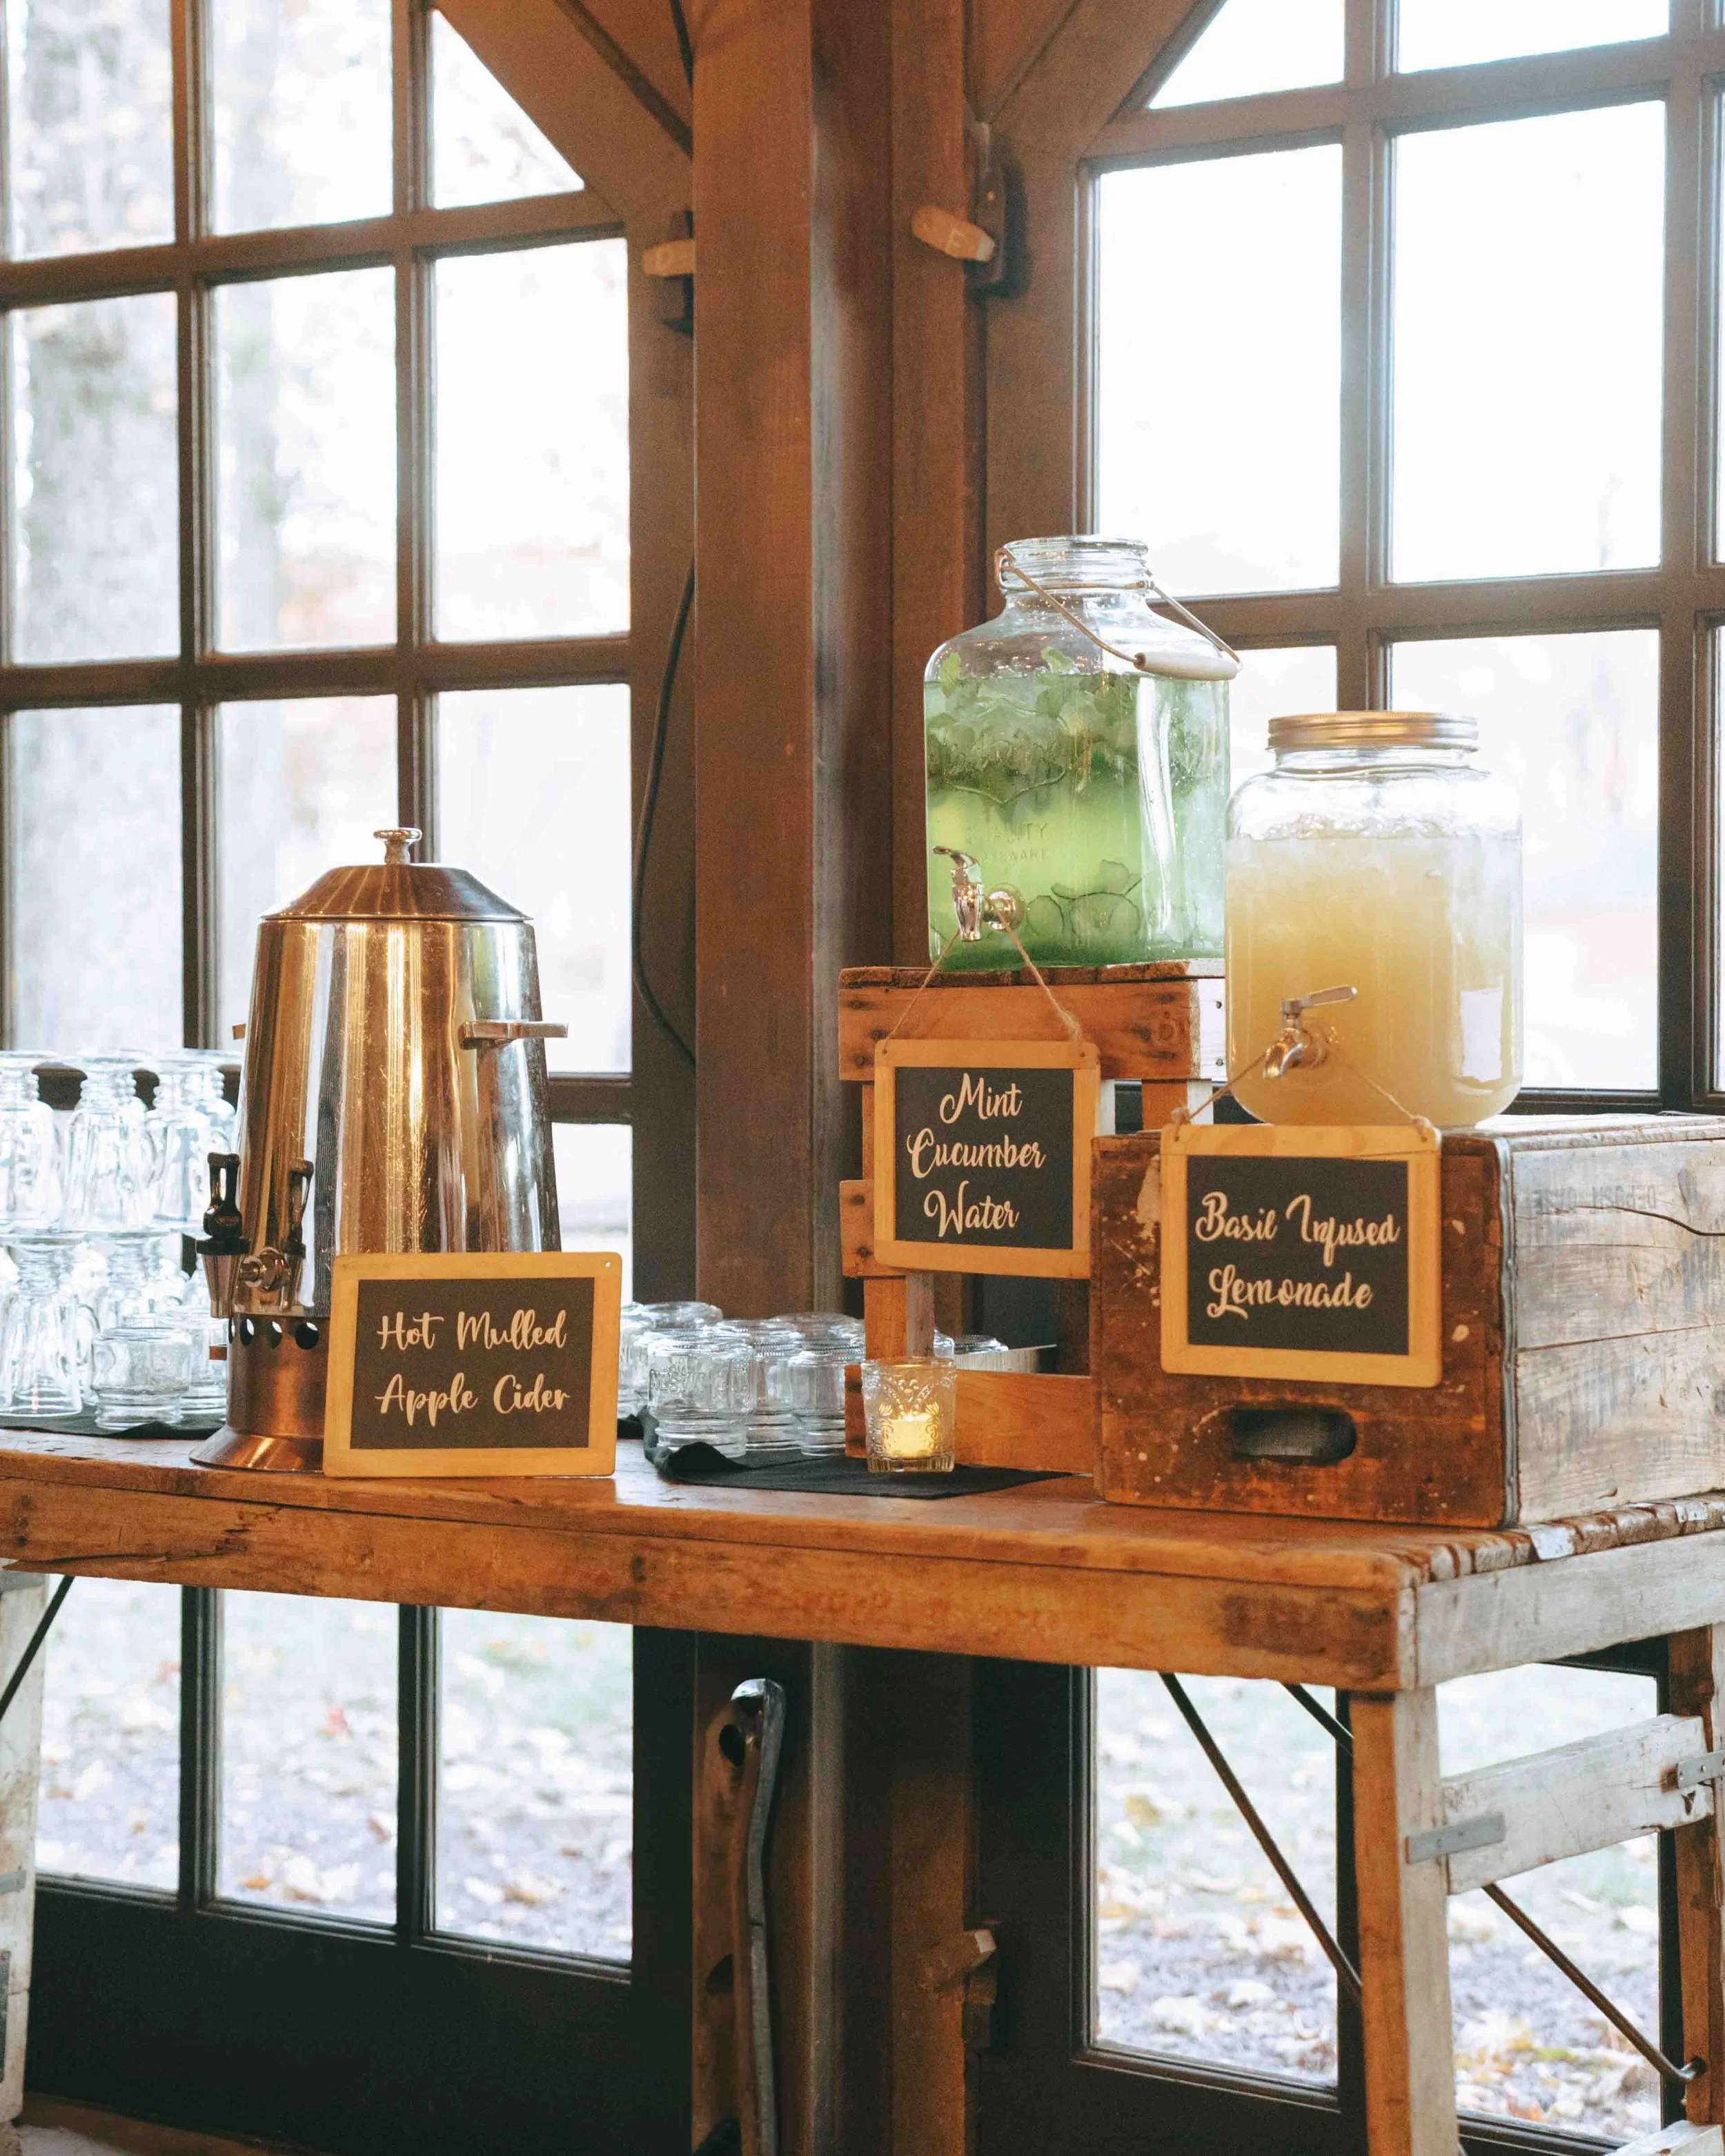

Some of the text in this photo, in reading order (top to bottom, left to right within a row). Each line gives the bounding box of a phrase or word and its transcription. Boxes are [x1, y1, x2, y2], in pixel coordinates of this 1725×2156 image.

[939, 1073, 1023, 1124] Mint
[906, 1127, 1046, 1178] Cucumber
[923, 1180, 1019, 1238] Water
[1195, 1191, 1400, 1267] Basil Infused
[1207, 1264, 1372, 1319] Lemonade
[377, 1309, 567, 1351] Hot Mulled
[374, 1372, 571, 1427] Apple Cider
